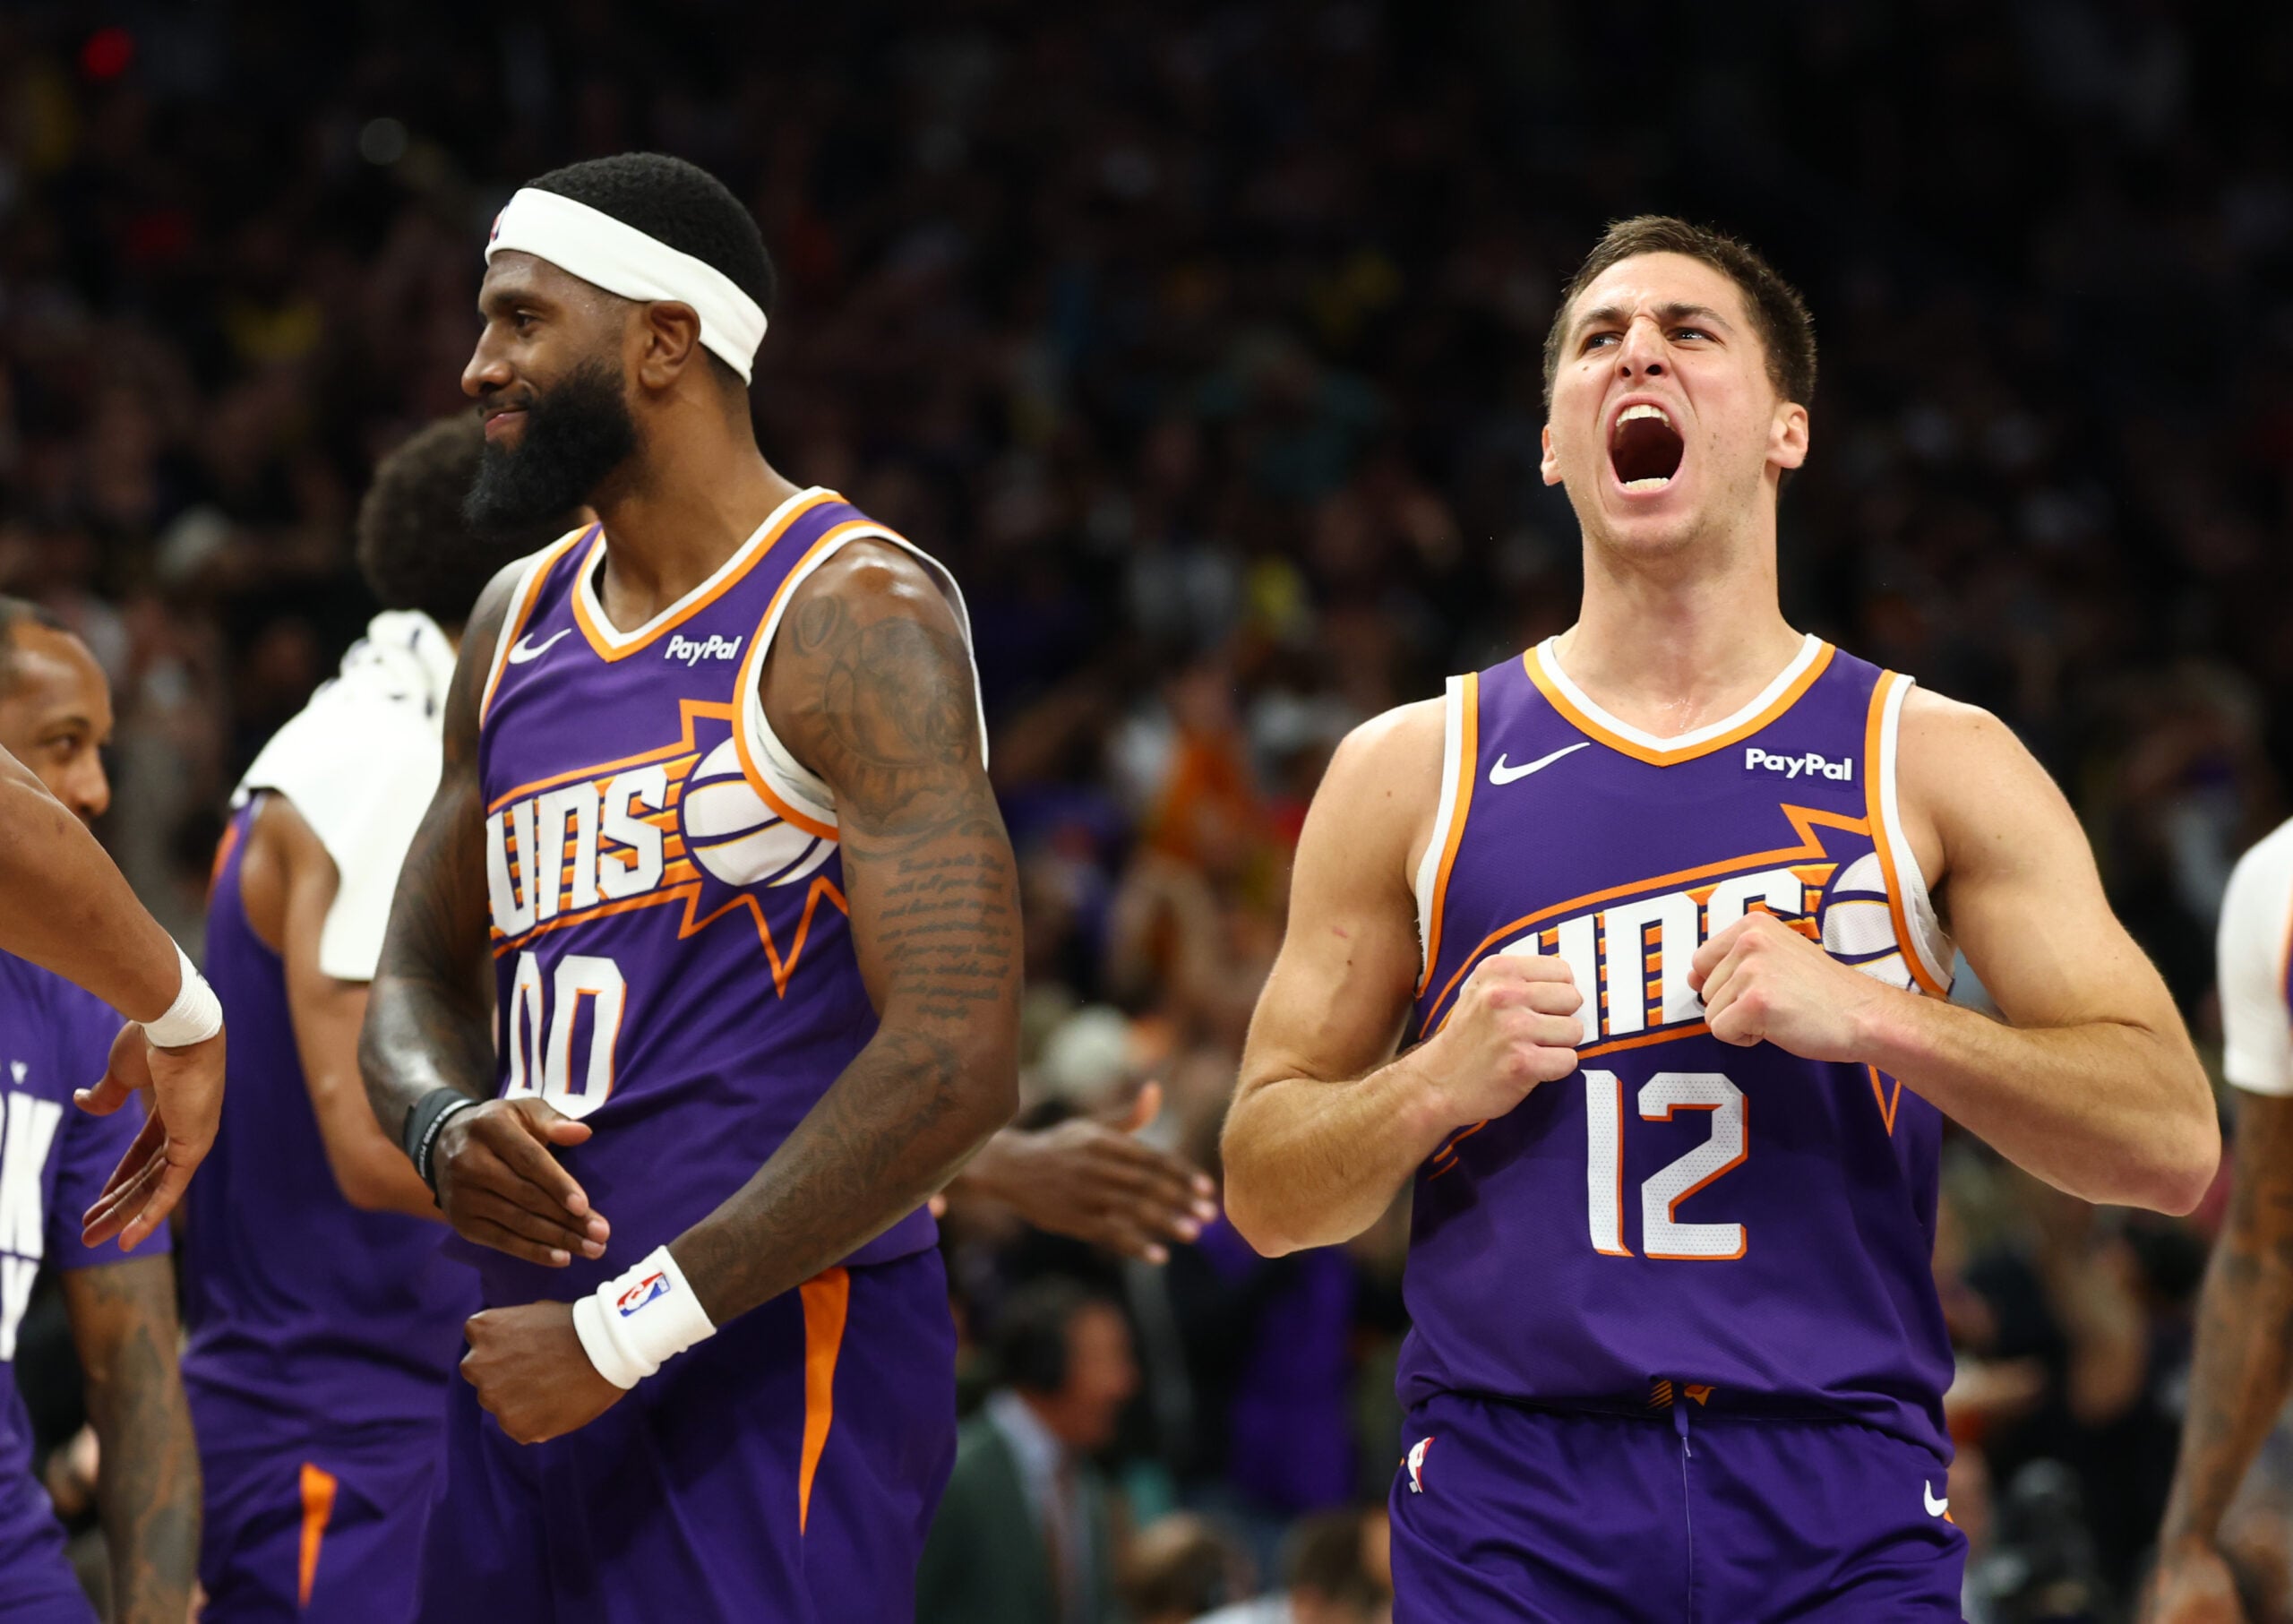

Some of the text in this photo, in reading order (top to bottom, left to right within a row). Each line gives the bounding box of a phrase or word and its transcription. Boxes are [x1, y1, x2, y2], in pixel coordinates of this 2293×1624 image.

[664, 634, 743, 667] PayPal
[1745, 747, 1853, 781] PayPal
[485, 763, 668, 938] UNS
[507, 950, 628, 1121] 00
[1580, 1069, 1748, 1261] 12
